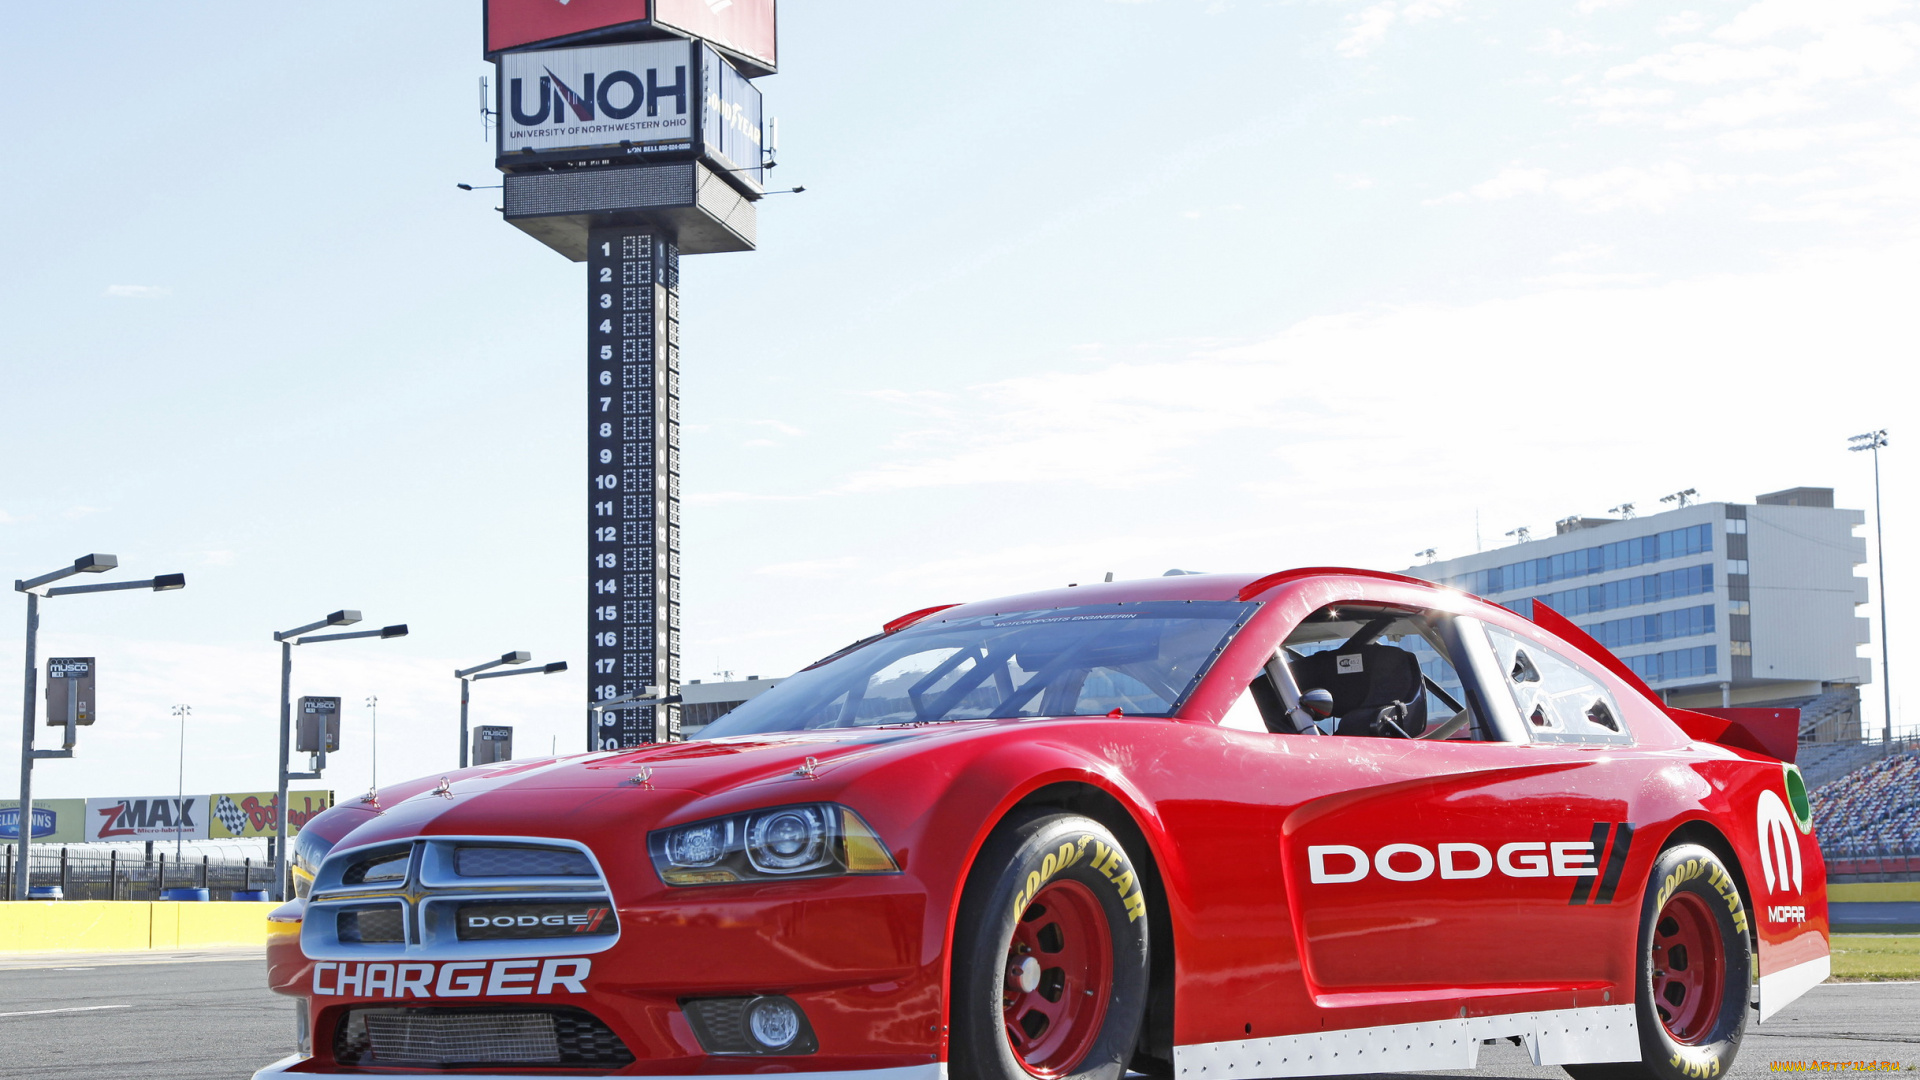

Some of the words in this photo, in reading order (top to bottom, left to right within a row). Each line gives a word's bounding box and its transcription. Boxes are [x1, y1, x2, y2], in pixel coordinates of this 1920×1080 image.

[510, 64, 686, 126] UNOH
[510, 127, 566, 138] UNIVERSITY
[567, 126, 580, 135] OF
[581, 120, 660, 134] NORTHWESTERN
[662, 118, 687, 128] OHIO
[602, 242, 610, 256] 1
[600, 268, 612, 282] 2
[600, 294, 612, 308] 3
[600, 319, 612, 333] 4
[600, 345, 612, 360] 5
[600, 371, 612, 385] 6
[600, 397, 612, 411] 7
[600, 423, 612, 437] 8
[600, 449, 612, 464] 9
[595, 474, 617, 489] 10
[595, 501, 613, 515] 11
[595, 527, 616, 541] 12
[595, 553, 617, 568] 13
[595, 579, 617, 594] 14
[595, 606, 617, 620] 15
[595, 632, 617, 646] 16
[595, 658, 615, 673] 17
[595, 685, 617, 699] 18
[1308, 842, 1599, 884] DODGE
[468, 914, 589, 928] DODGE
[1768, 906, 1806, 922] MOPAR
[312, 958, 592, 998] CHARGER
[1669, 1050, 1720, 1079] EAGLE
